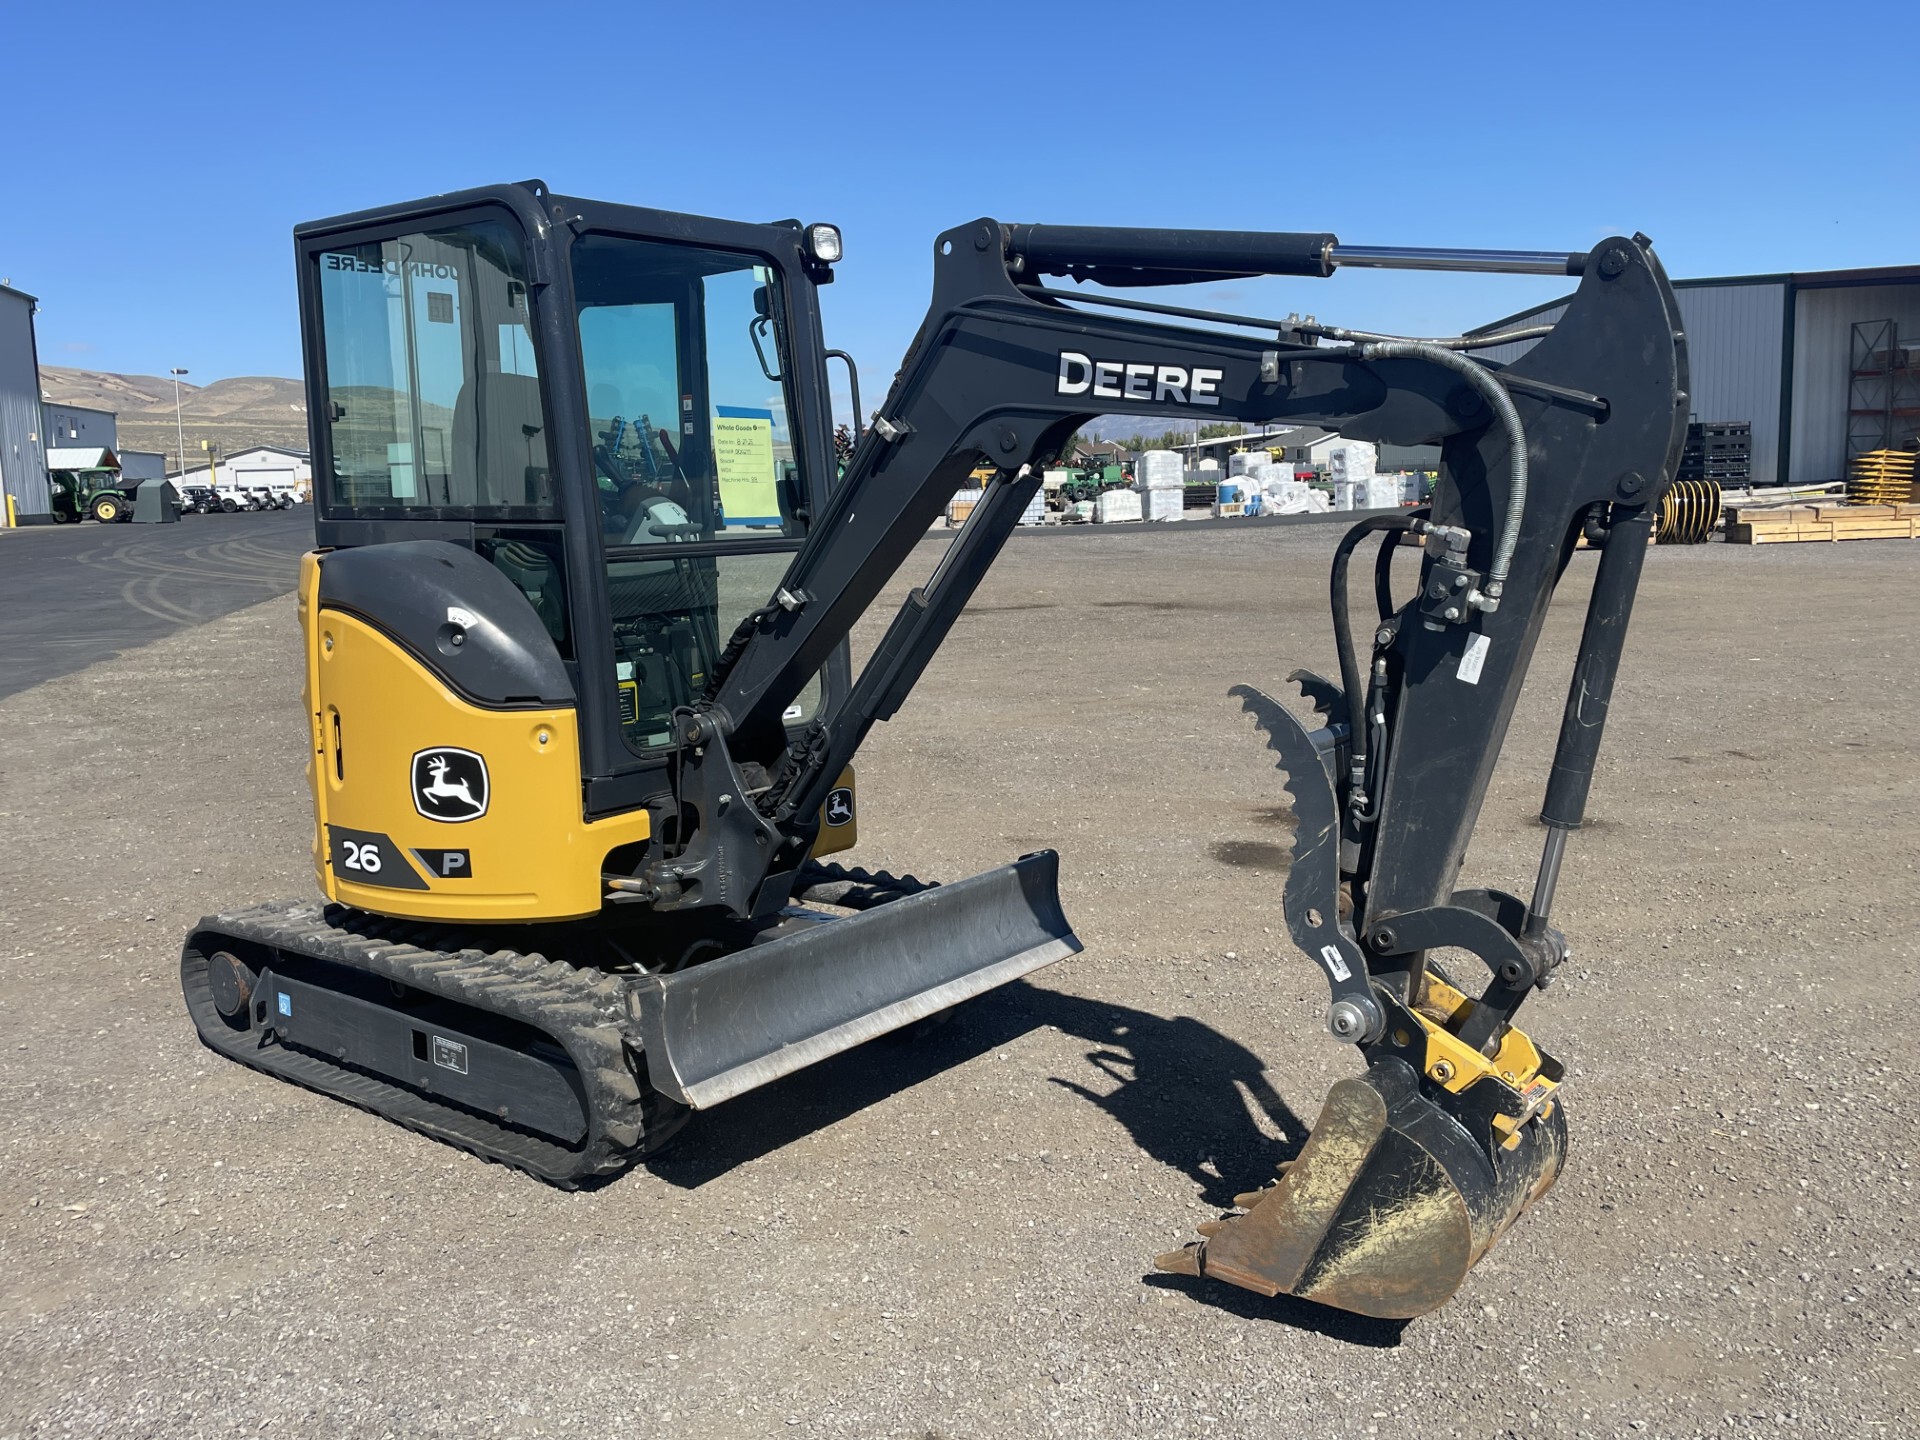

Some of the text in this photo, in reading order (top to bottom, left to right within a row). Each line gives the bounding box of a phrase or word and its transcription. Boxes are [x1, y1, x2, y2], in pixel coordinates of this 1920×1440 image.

[1058, 351, 1223, 406] DEERE
[342, 840, 382, 873] 26
[442, 852, 465, 876] P
